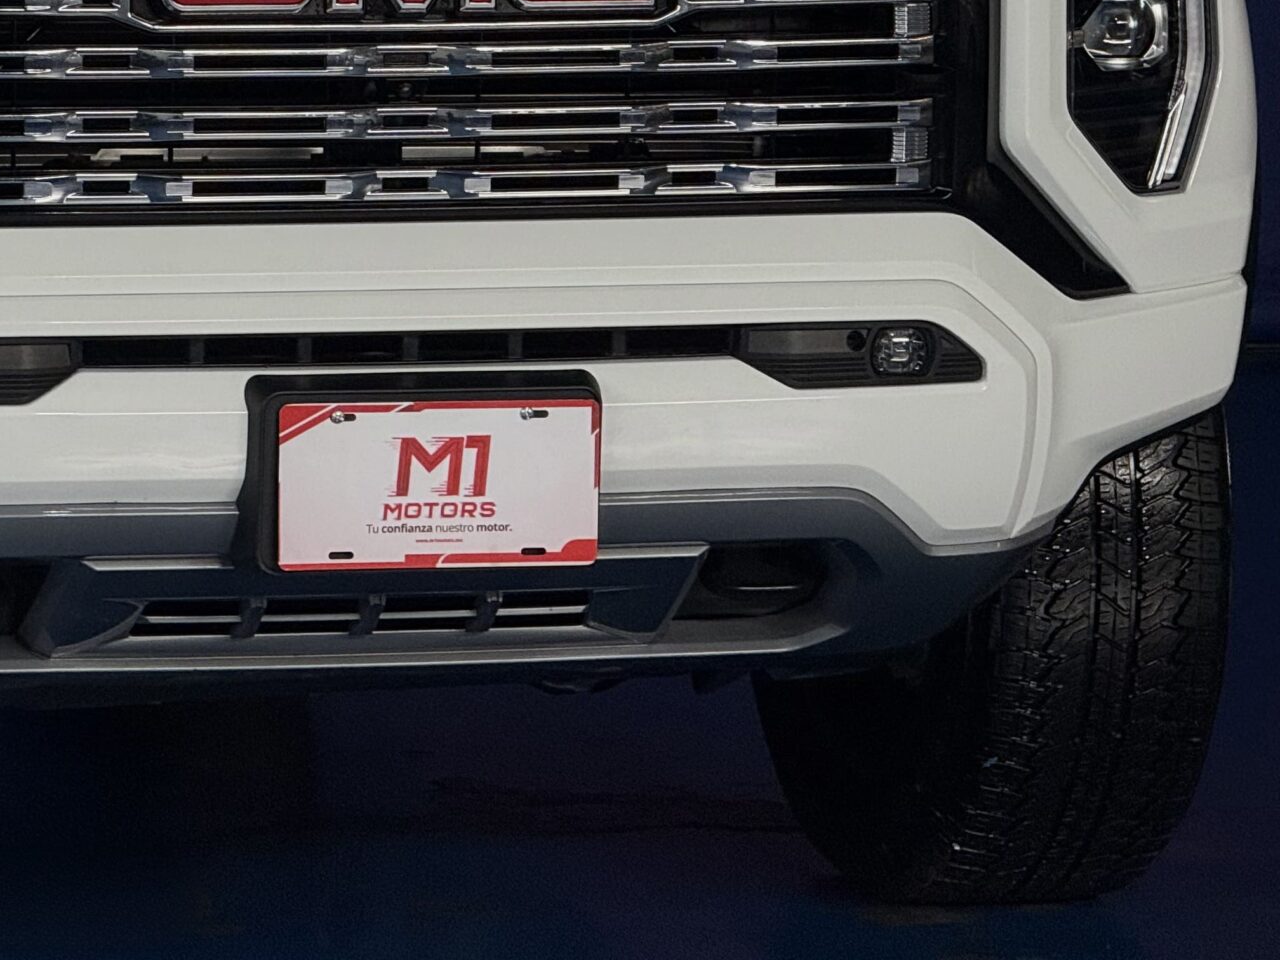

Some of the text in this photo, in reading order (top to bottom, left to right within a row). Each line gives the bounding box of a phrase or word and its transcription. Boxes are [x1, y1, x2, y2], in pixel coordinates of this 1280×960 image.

[386, 434, 491, 497] M1
[382, 501, 497, 521] MOTORS
[366, 522, 513, 534] Tu confianza nuestro motor.
